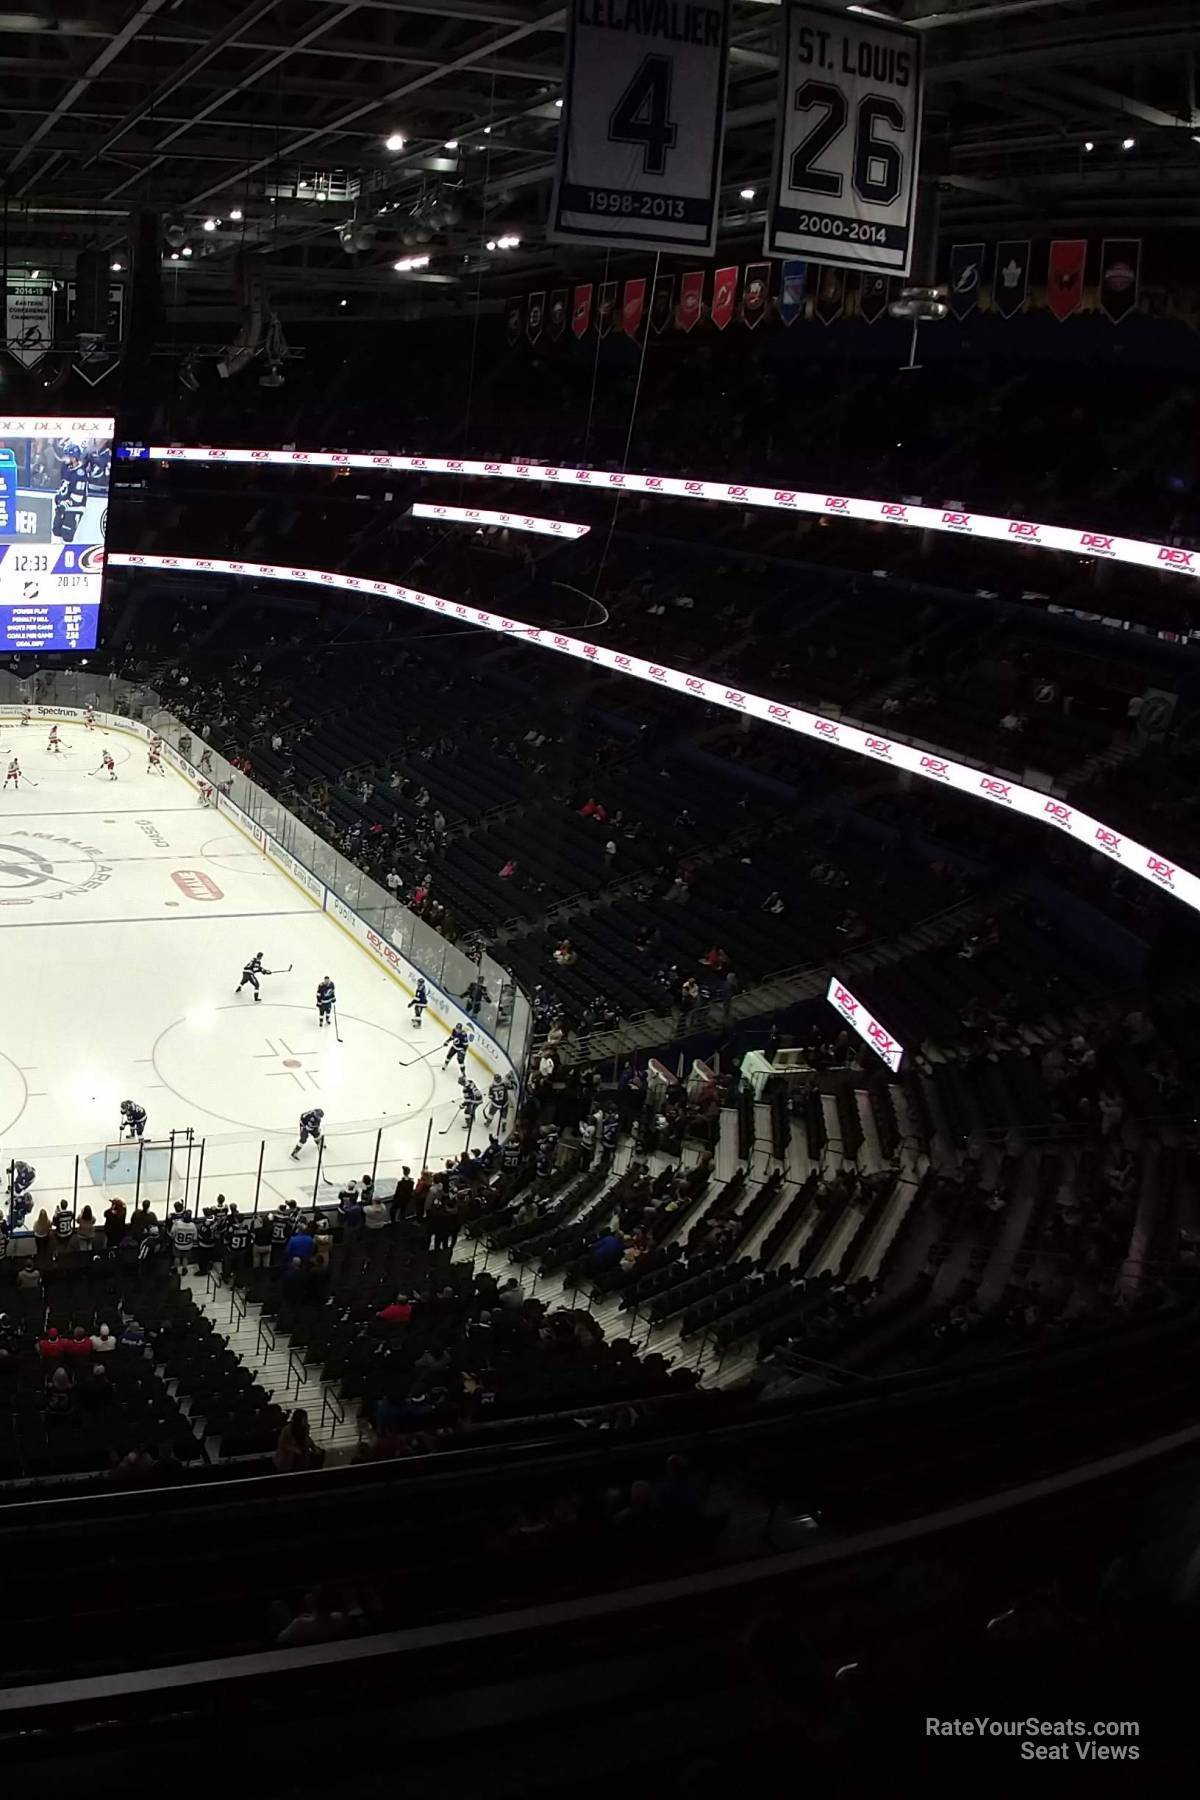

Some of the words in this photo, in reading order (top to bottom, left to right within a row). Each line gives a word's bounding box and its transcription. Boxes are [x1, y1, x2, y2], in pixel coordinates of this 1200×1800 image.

[578, 0, 720, 48] LECAVALIER
[798, 26, 834, 70] ST.
[842, 37, 911, 88] LOUIS
[608, 52, 678, 176] 4
[789, 79, 906, 208] 26
[588, 191, 685, 219] 1998-2013
[798, 215, 888, 244] 2000-2014
[609, 475, 624, 483] DEX
[645, 479, 663, 487] DEX
[684, 483, 703, 491] DEX
[728, 487, 748, 496] DEX
[774, 492, 796, 502] DEX
[825, 498, 849, 509] DEX
[881, 505, 907, 517] DEX
[942, 513, 970, 526] DEX
[1008, 523, 1038, 536] DEX
[1013, 535, 1042, 543] imaging
[1080, 536, 1114, 551] DEX
[1086, 547, 1116, 557] imaging
[1157, 549, 1193, 565] DEX
[14, 556, 49, 572] 12:33
[64, 551, 75, 568] 0
[1165, 562, 1196, 573] imaging
[478, 613, 490, 621] DEX
[554, 636, 569, 646] DEX
[614, 656, 631, 666] DEX
[648, 666, 667, 677] DEX
[685, 678, 704, 690] DEX
[725, 691, 746, 704] DEX
[37, 706, 76, 718] Spectrum
[768, 705, 791, 718] DEX
[814, 720, 839, 735] DEX
[865, 737, 891, 753] DEX
[920, 757, 949, 774] DEX
[980, 778, 1011, 796] DEX
[1044, 801, 1072, 821] DEX
[1095, 828, 1121, 849] DEX
[1147, 856, 1175, 881] DEX
[367, 930, 383, 950] DEX
[384, 947, 401, 965] DEX
[833, 986, 859, 1015] DEX
[867, 1021, 894, 1052] DEX
[503, 1156, 519, 1168] 20
[58, 1220, 73, 1234] 91
[272, 1227, 286, 1239] 91
[231, 1237, 247, 1249] 91
